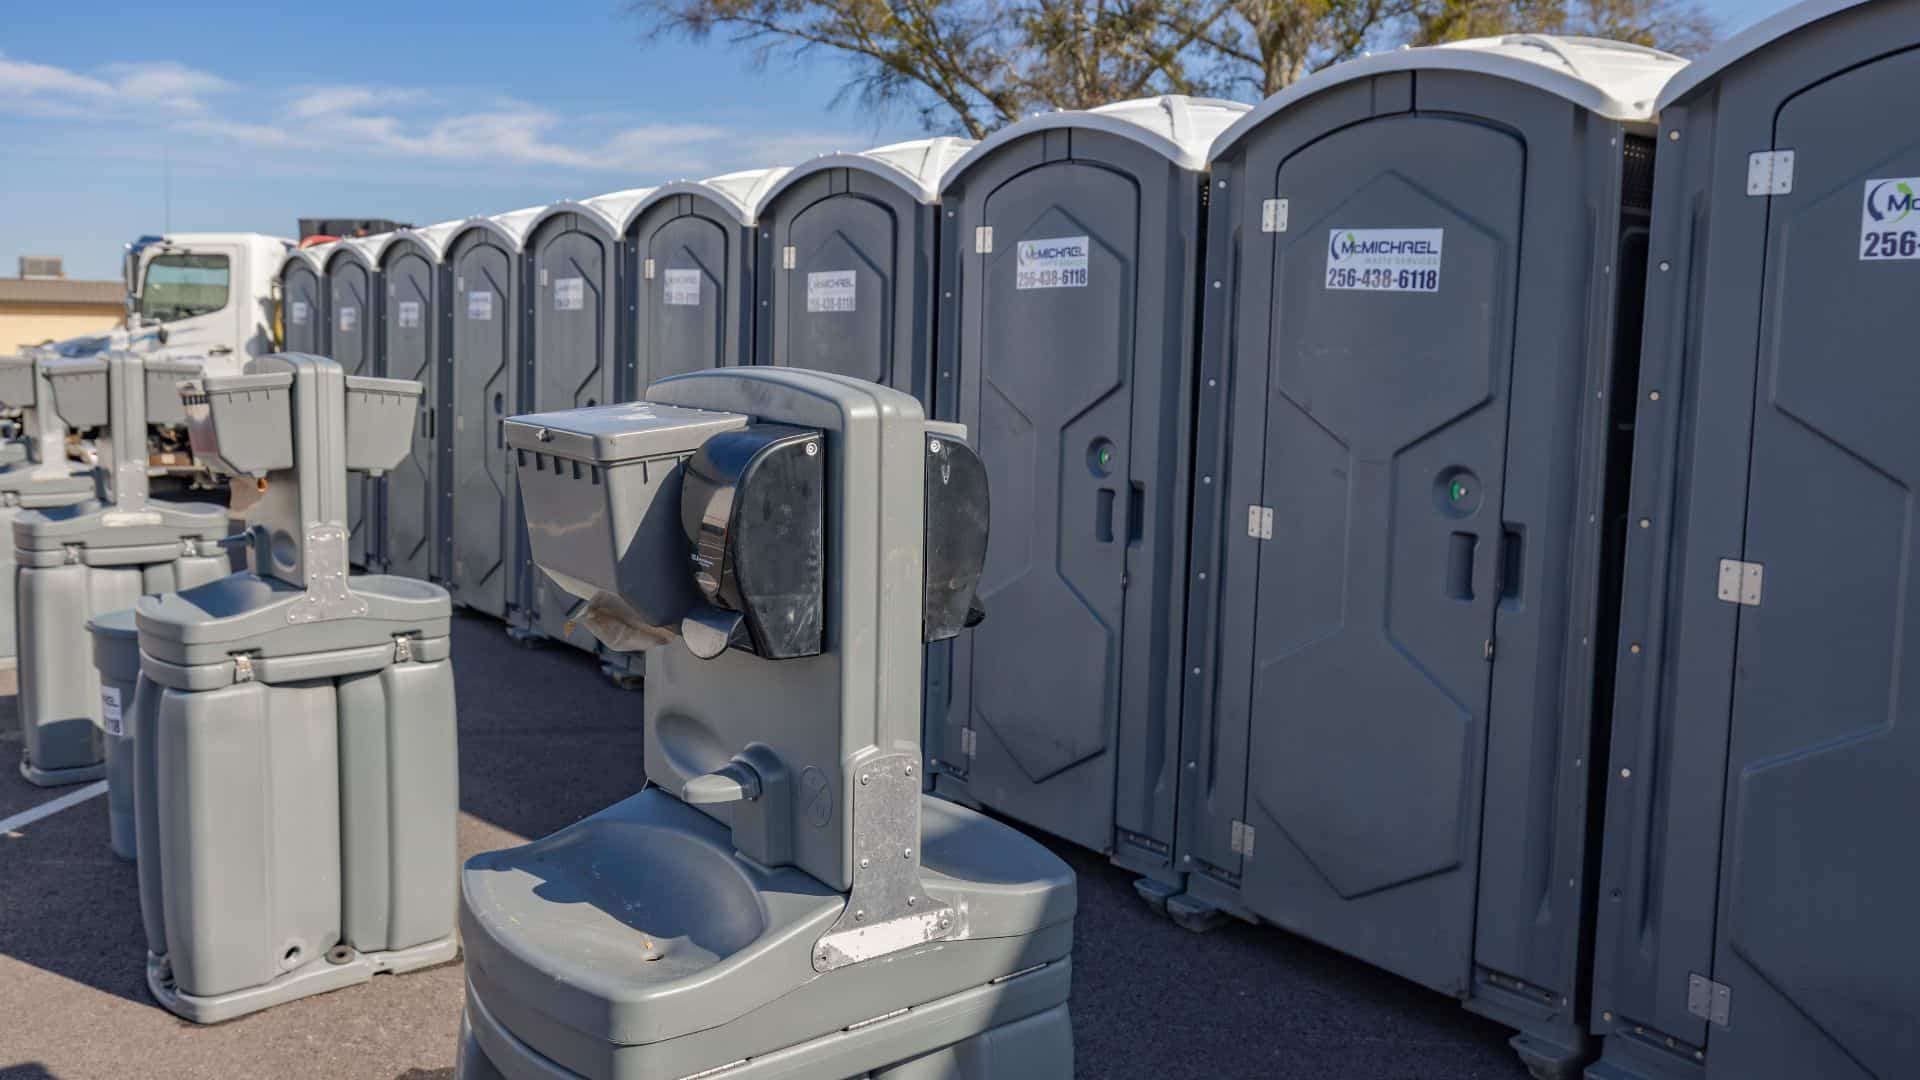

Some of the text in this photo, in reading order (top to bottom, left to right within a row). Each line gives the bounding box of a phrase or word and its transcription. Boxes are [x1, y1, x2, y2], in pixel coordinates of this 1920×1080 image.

[1341, 240, 1439, 255] McMICHAEL
[1864, 231, 1920, 257] 256
[1327, 267, 1438, 289] 256-438-6118
